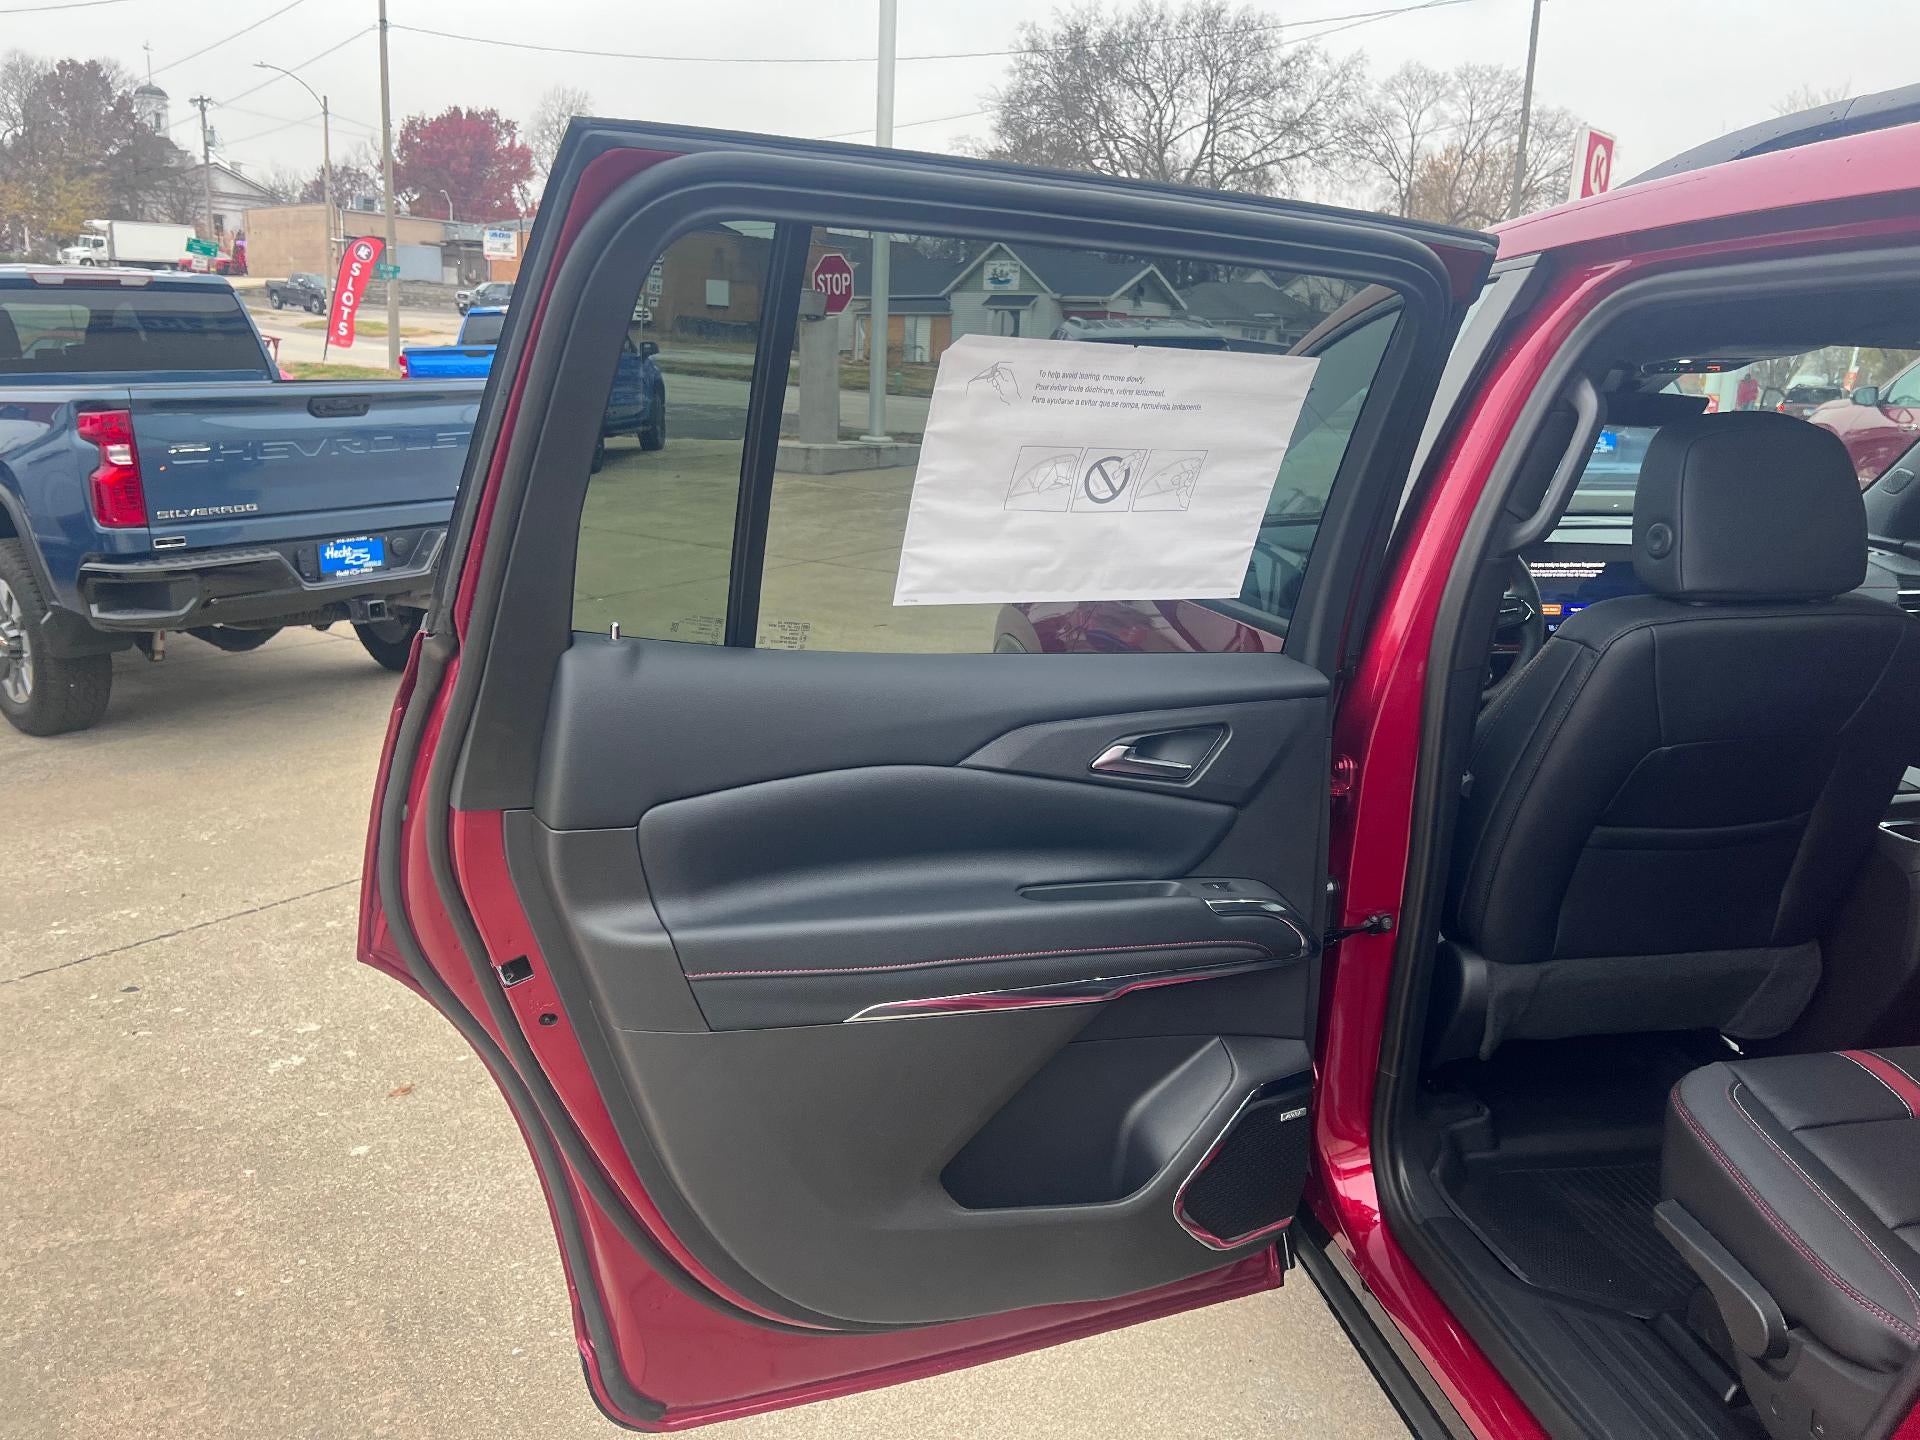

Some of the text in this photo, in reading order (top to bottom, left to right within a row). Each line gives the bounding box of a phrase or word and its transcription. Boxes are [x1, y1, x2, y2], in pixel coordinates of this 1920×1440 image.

[1593, 154, 1605, 183] K
[817, 273, 851, 296] STOP
[337, 262, 362, 336] SLOTS
[157, 503, 258, 519] SILVERADO
[325, 544, 352, 560] Hecht
